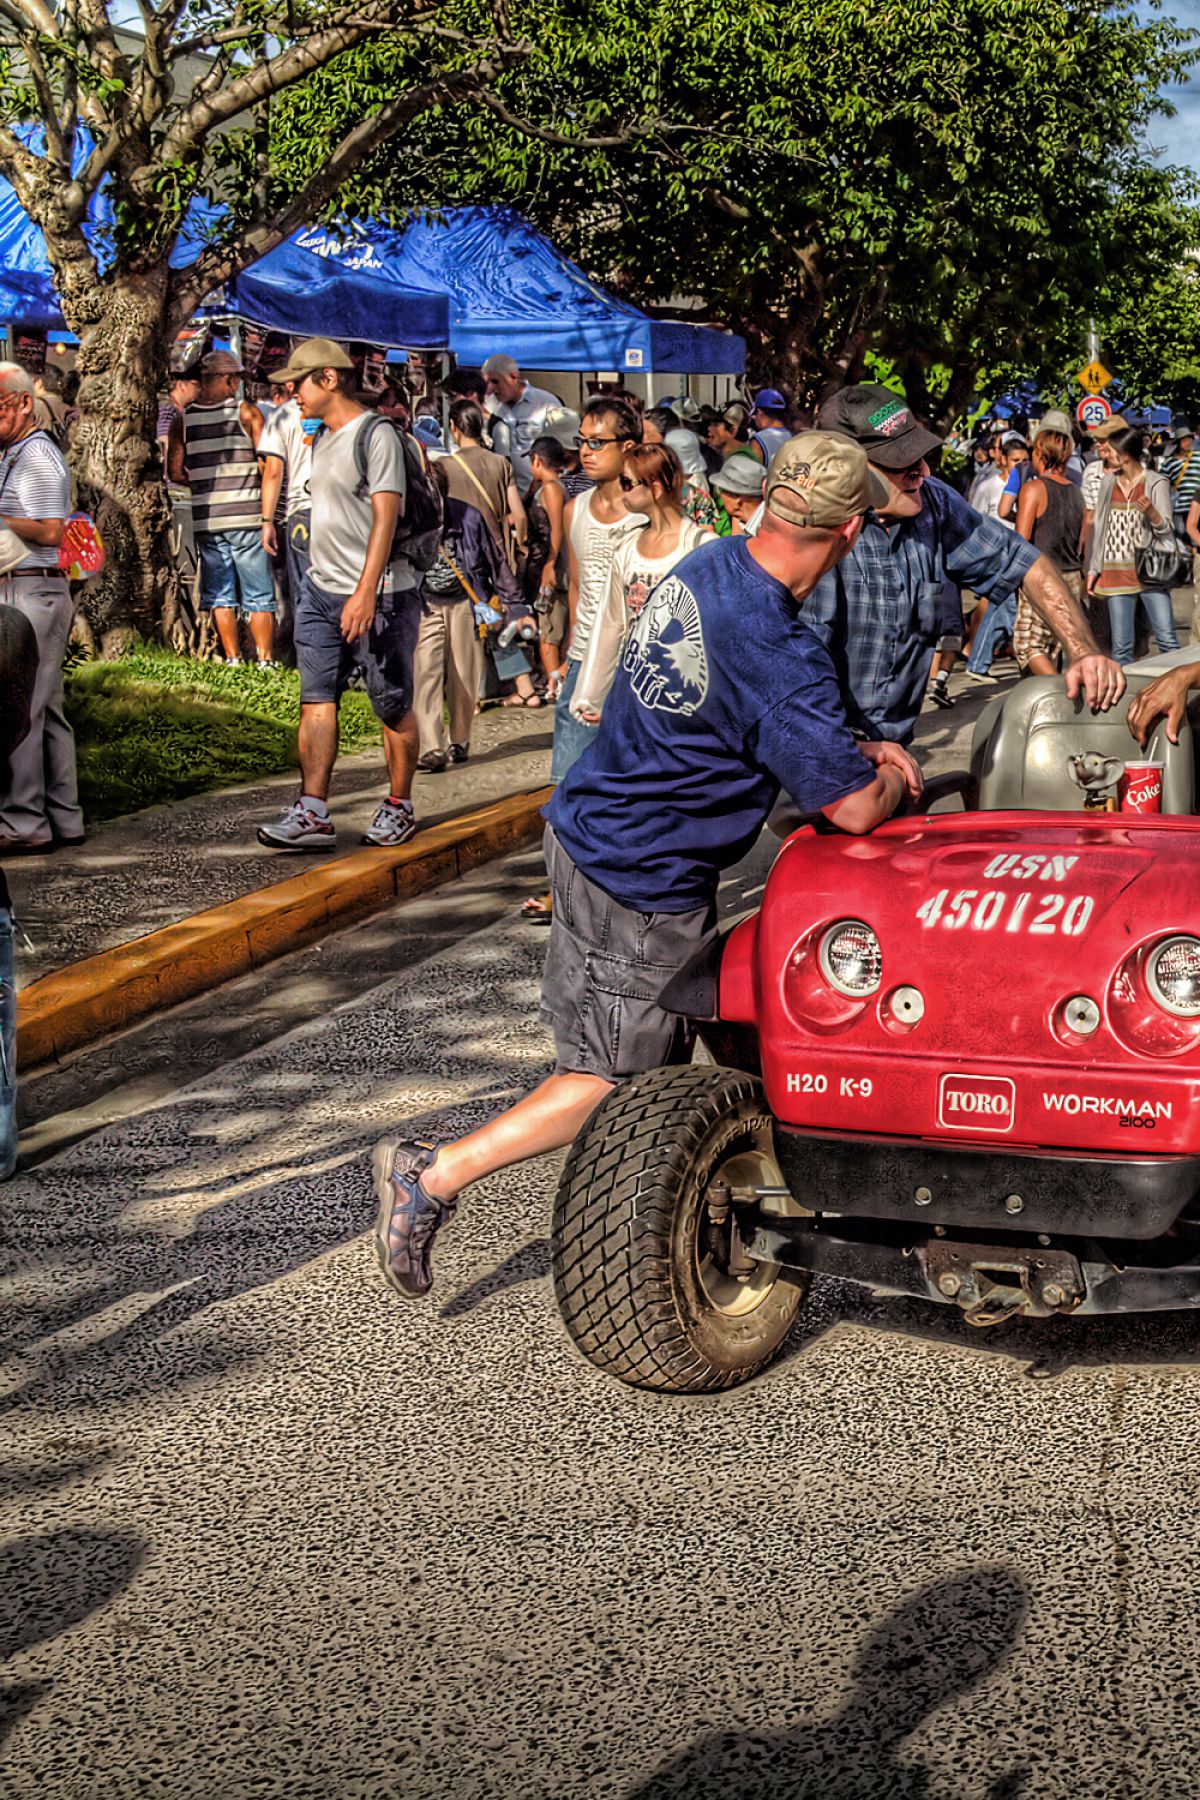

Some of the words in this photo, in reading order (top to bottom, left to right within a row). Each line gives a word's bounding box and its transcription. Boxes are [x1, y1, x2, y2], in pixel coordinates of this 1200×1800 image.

[1084, 406, 1104, 421] 25
[1126, 783, 1161, 806] Coke
[983, 854, 1079, 882] USN
[916, 889, 1094, 935] 450120
[840, 1077, 873, 1097] K-9
[1043, 1092, 1172, 1119] WORKMAN
[1119, 1115, 1156, 1129] 2100
